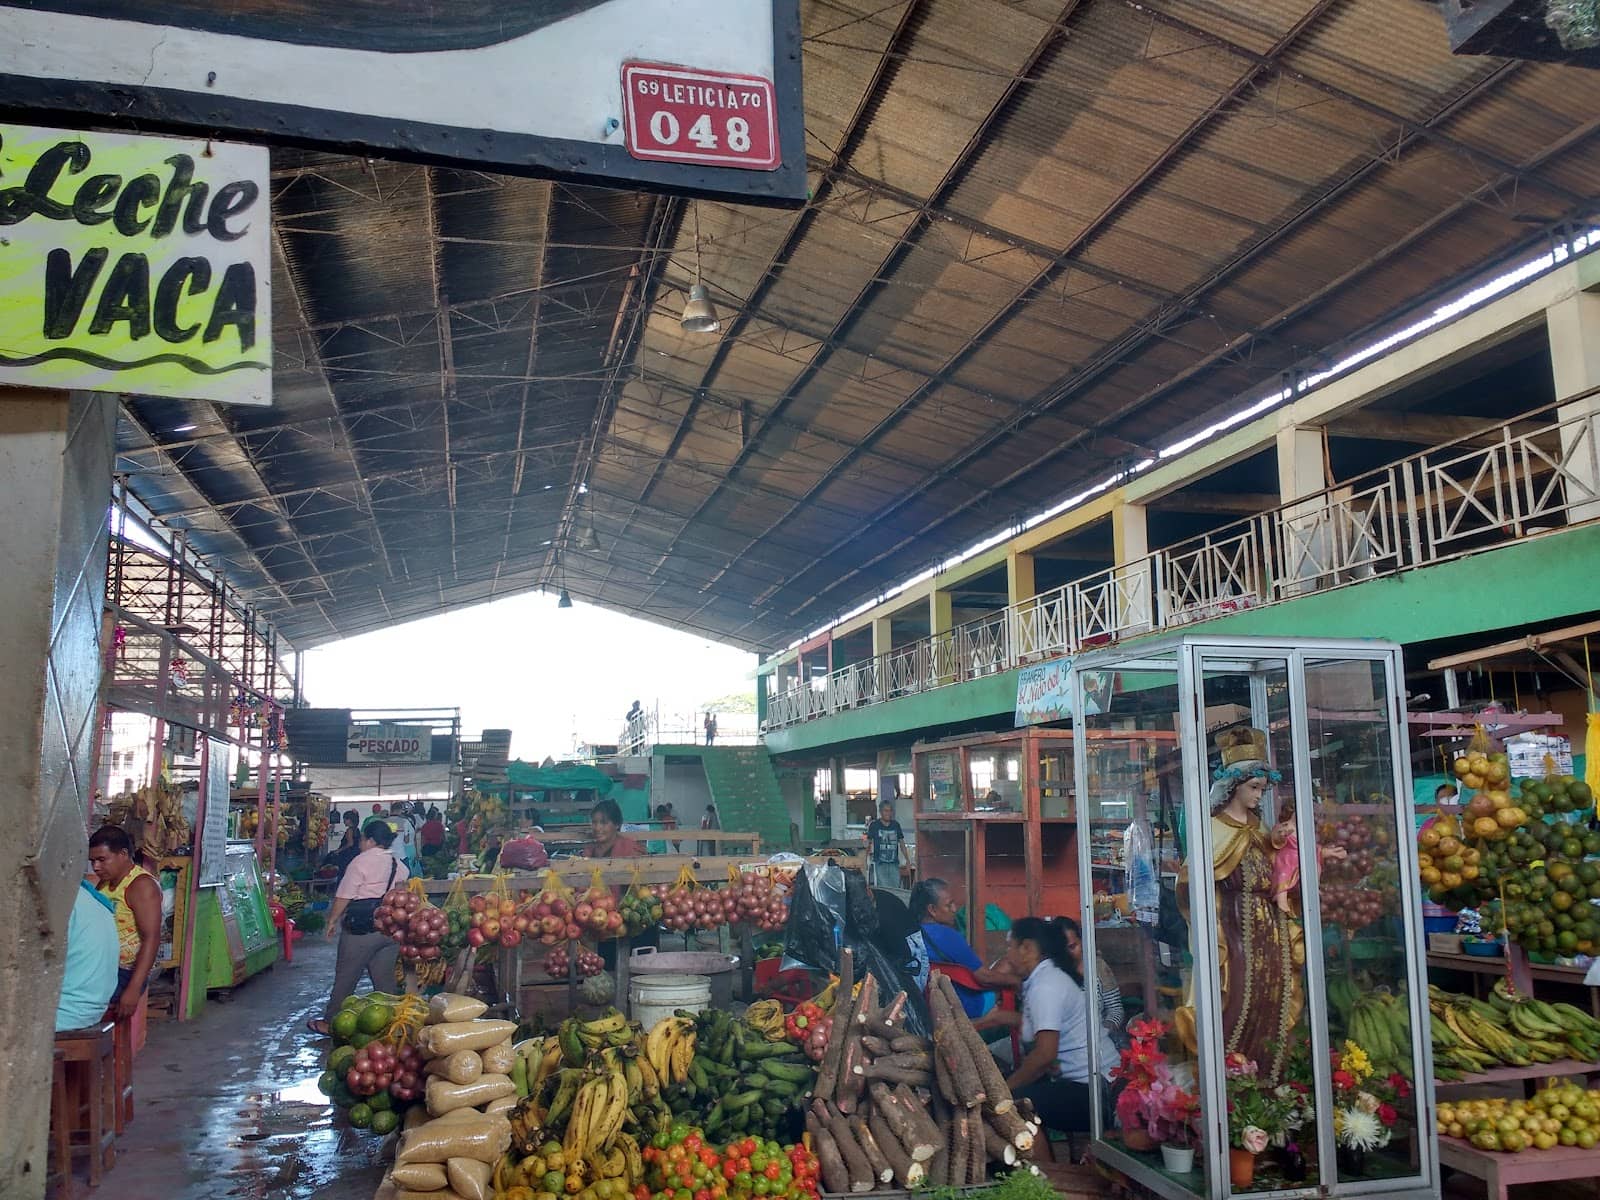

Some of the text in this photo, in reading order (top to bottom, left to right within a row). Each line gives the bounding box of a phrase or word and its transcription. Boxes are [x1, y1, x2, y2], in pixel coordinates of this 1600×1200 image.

[637, 79, 762, 110] 69 LETICIA 70
[650, 110, 752, 153] 048
[0, 141, 259, 242] Leche
[43, 247, 257, 353] VACA
[359, 739, 419, 753] PESCADO
